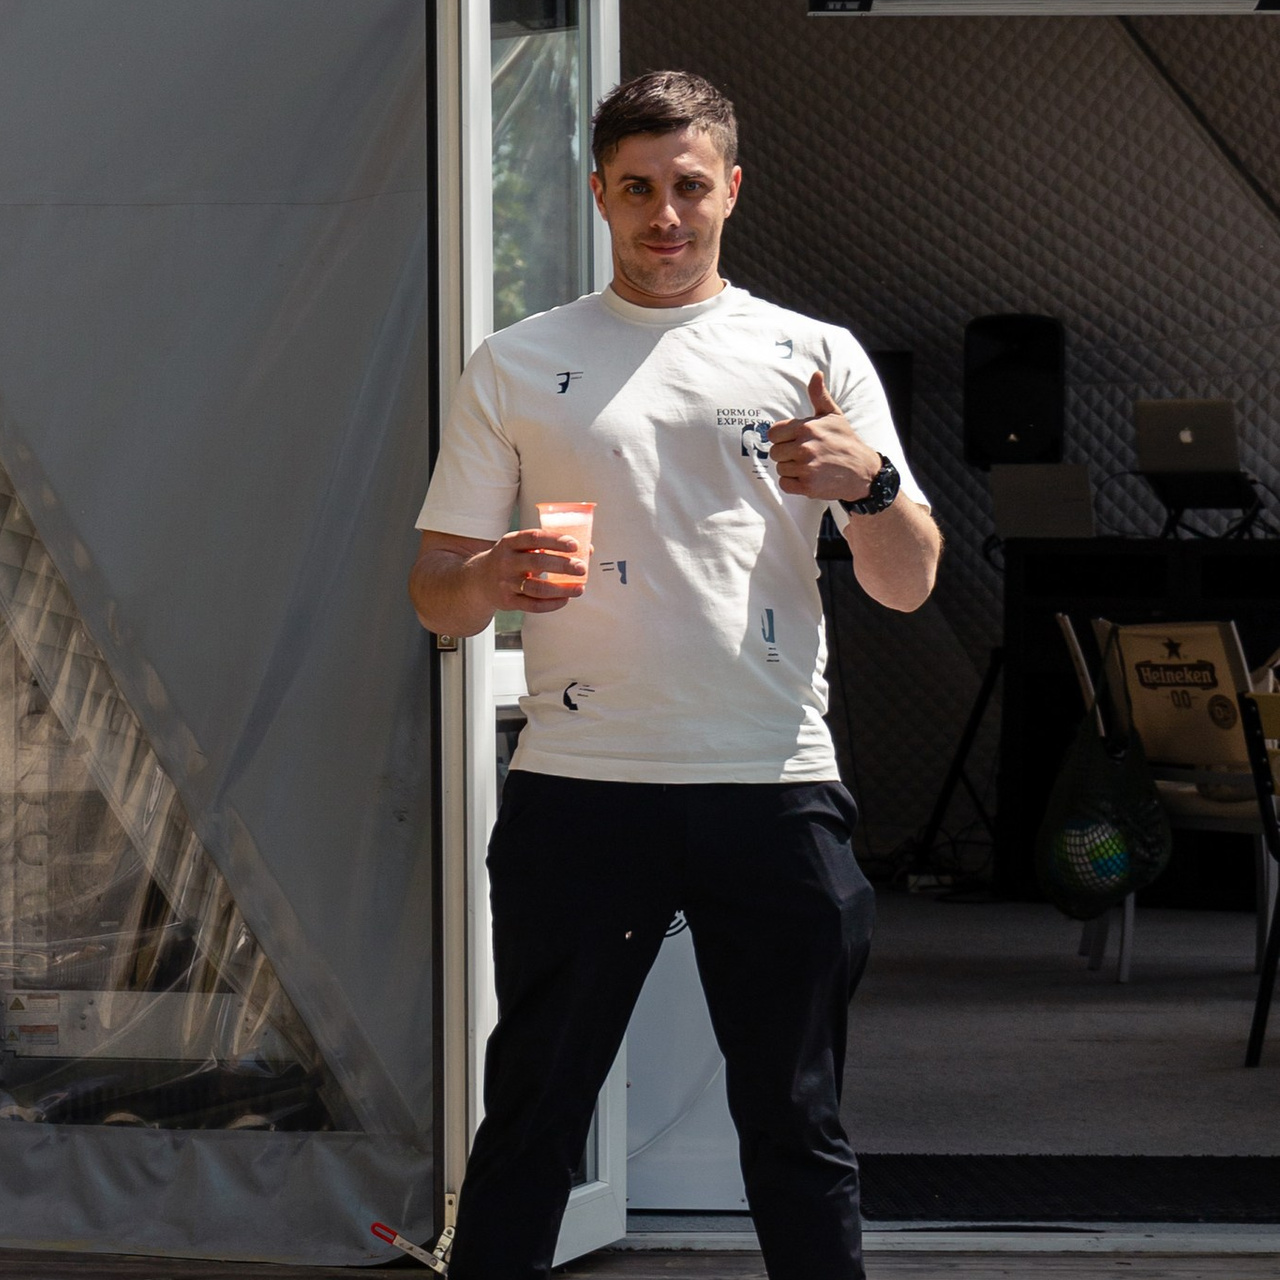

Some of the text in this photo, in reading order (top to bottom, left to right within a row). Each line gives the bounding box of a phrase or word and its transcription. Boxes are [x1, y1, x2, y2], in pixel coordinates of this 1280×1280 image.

[716, 408, 762, 417] FORM OF
[1140, 666, 1213, 684] Heineken
